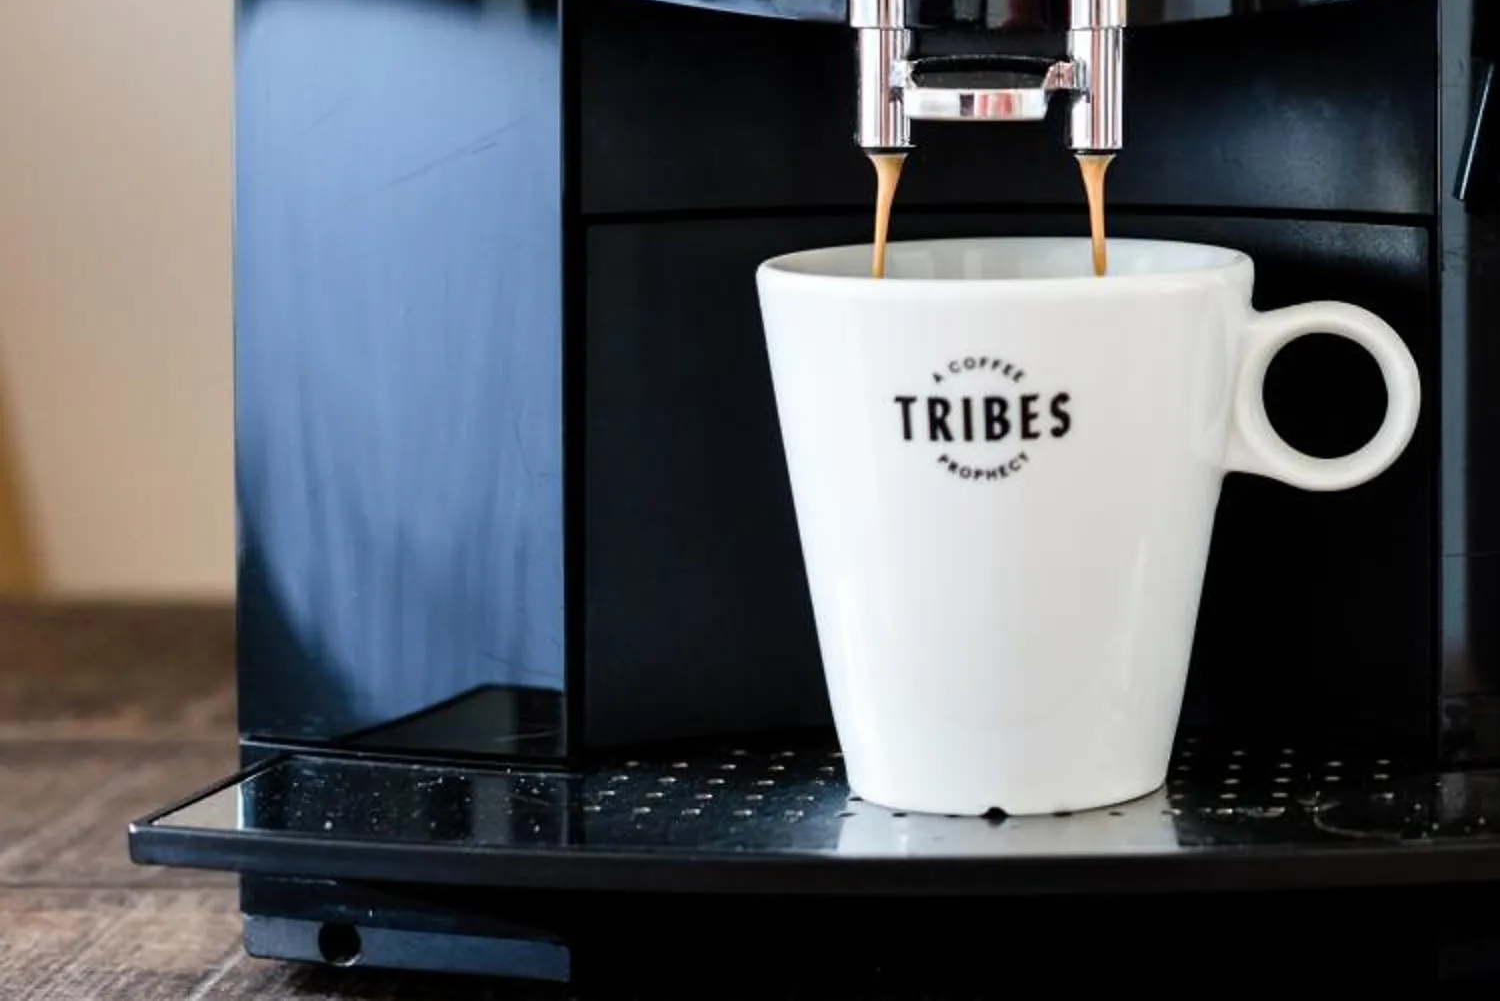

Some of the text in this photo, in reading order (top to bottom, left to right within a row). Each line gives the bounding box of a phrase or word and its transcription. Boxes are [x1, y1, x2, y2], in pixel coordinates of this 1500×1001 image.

[932, 356, 1026, 384] A COFFEE
[894, 391, 1072, 442] TRIBES
[937, 450, 1030, 481] PROPHECY
